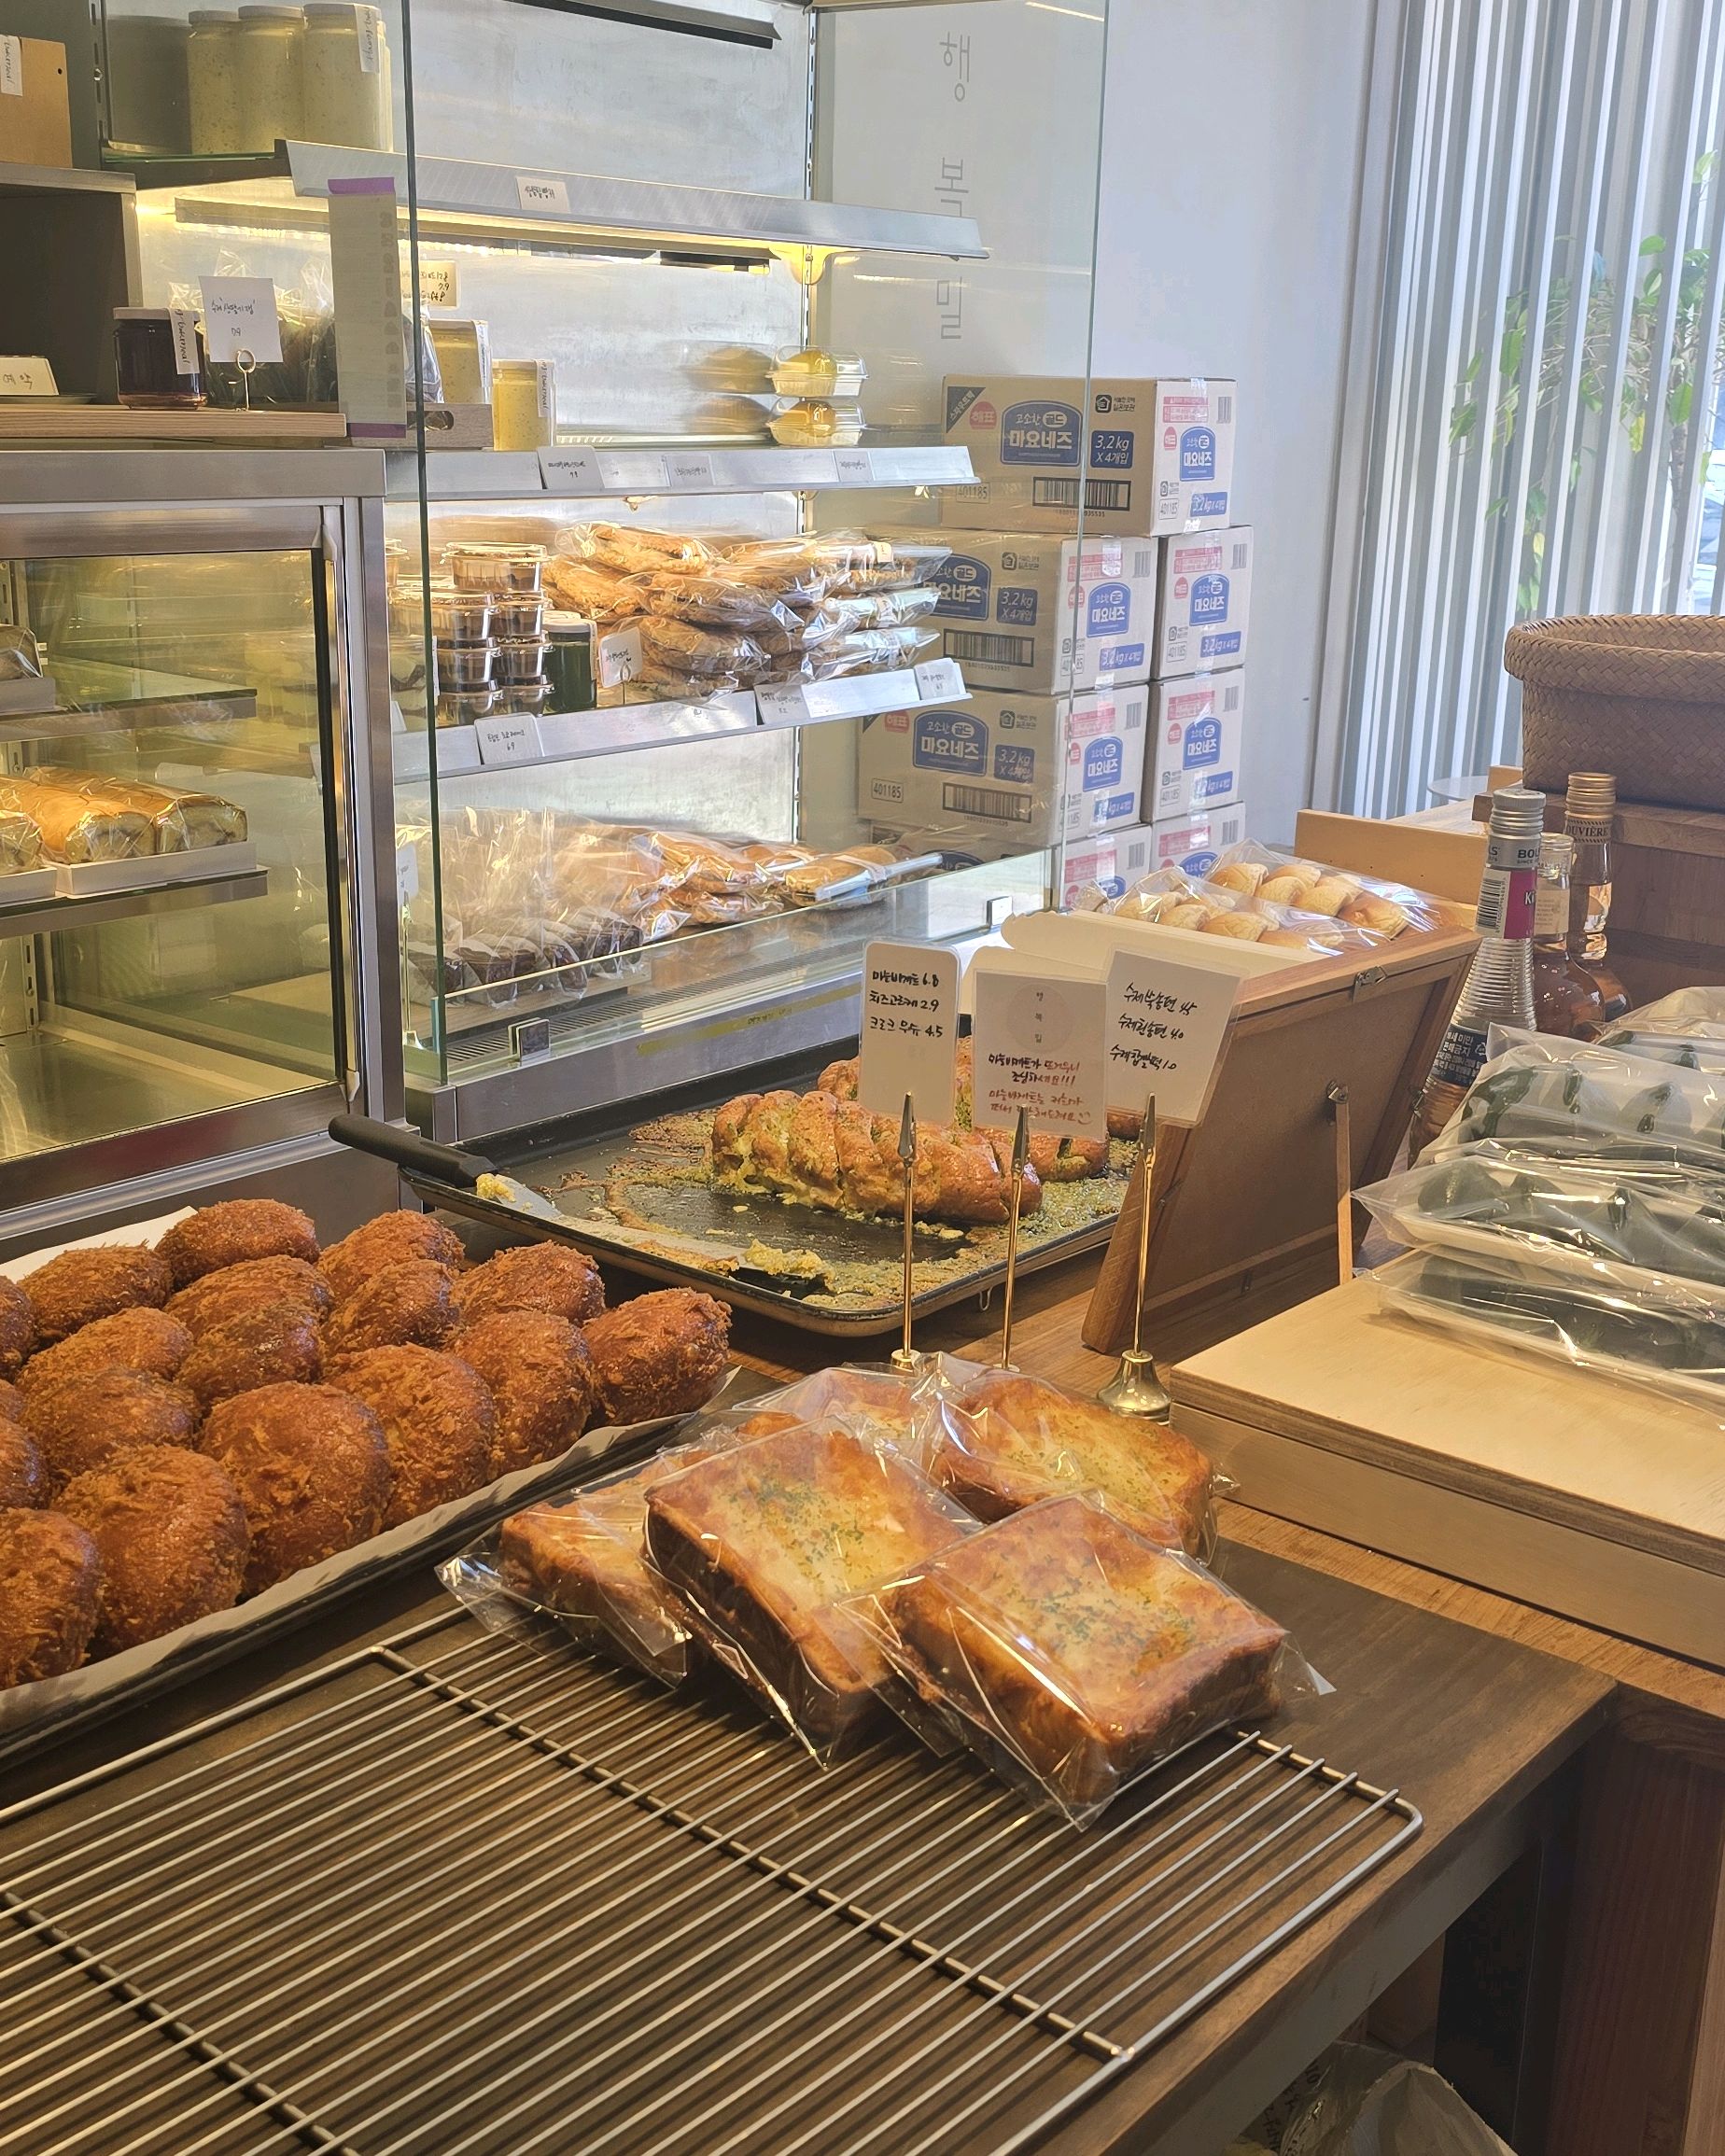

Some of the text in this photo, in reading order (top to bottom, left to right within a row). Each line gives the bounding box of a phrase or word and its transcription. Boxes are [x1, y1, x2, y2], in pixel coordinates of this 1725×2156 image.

[1016, 413, 1065, 427] 고소한 골드
[1009, 430, 1073, 450] 마요네즈
[1184, 452, 1213, 467] 마요네즈
[1195, 595, 1225, 612] 마요네즈
[1091, 605, 1126, 623] 마요네즈
[927, 721, 973, 737] 고소한 골드
[921, 736, 979, 761] 마요네즈
[1187, 739, 1217, 757] 마요네즈
[1088, 759, 1118, 777] 마요네즈
[874, 782, 902, 799] 401185
[873, 970, 939, 987] 마늘바게트 6.8
[920, 1000, 939, 1013] 2.9
[870, 1016, 895, 1032] 크로크
[924, 1025, 943, 1038] 4.5
[1118, 1013, 1185, 1040] 수제흰송편 4.0
[989, 1053, 1080, 1073] 마늘바게트가 뜨거우니
[1110, 1043, 1162, 1071] 수제찹쌀떡
[989, 1089, 1045, 1105] 마늘바게트는
